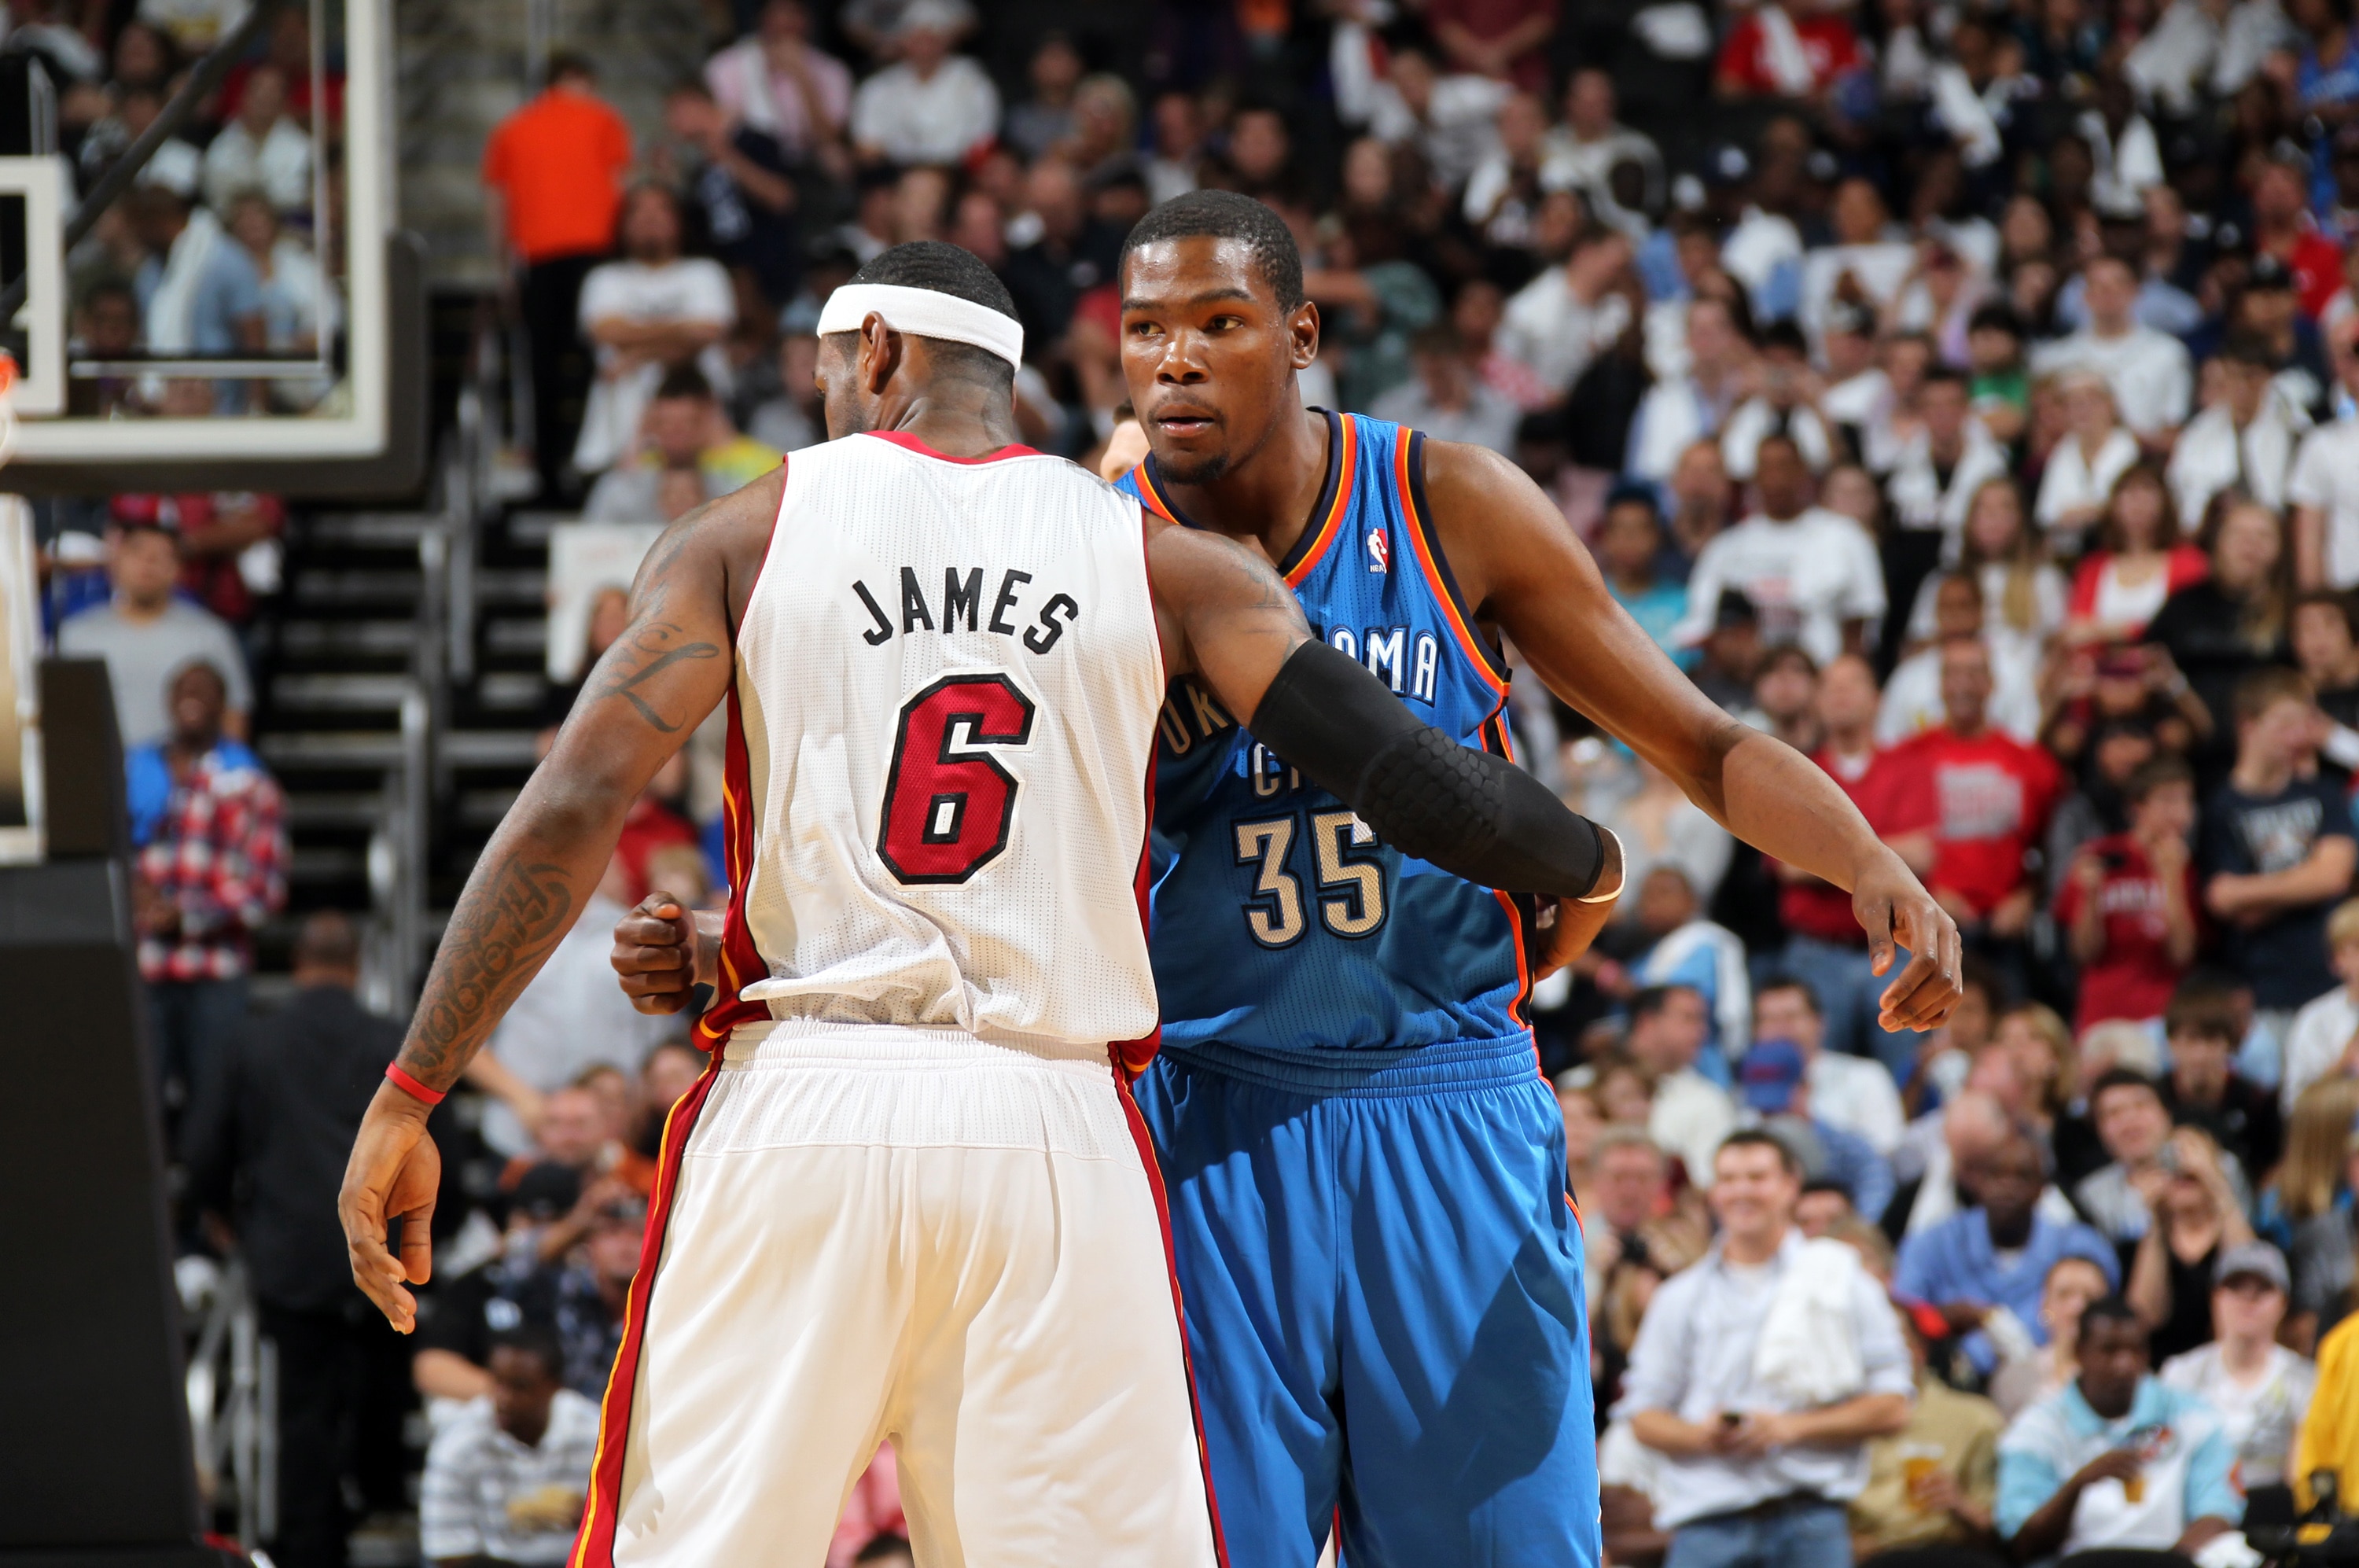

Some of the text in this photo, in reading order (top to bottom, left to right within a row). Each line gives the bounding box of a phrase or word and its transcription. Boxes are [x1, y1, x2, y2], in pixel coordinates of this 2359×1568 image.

[852, 566, 1079, 655] JAMES
[1370, 564, 1385, 572] NBA
[874, 667, 1040, 889] 6
[1230, 804, 1389, 951] 35
